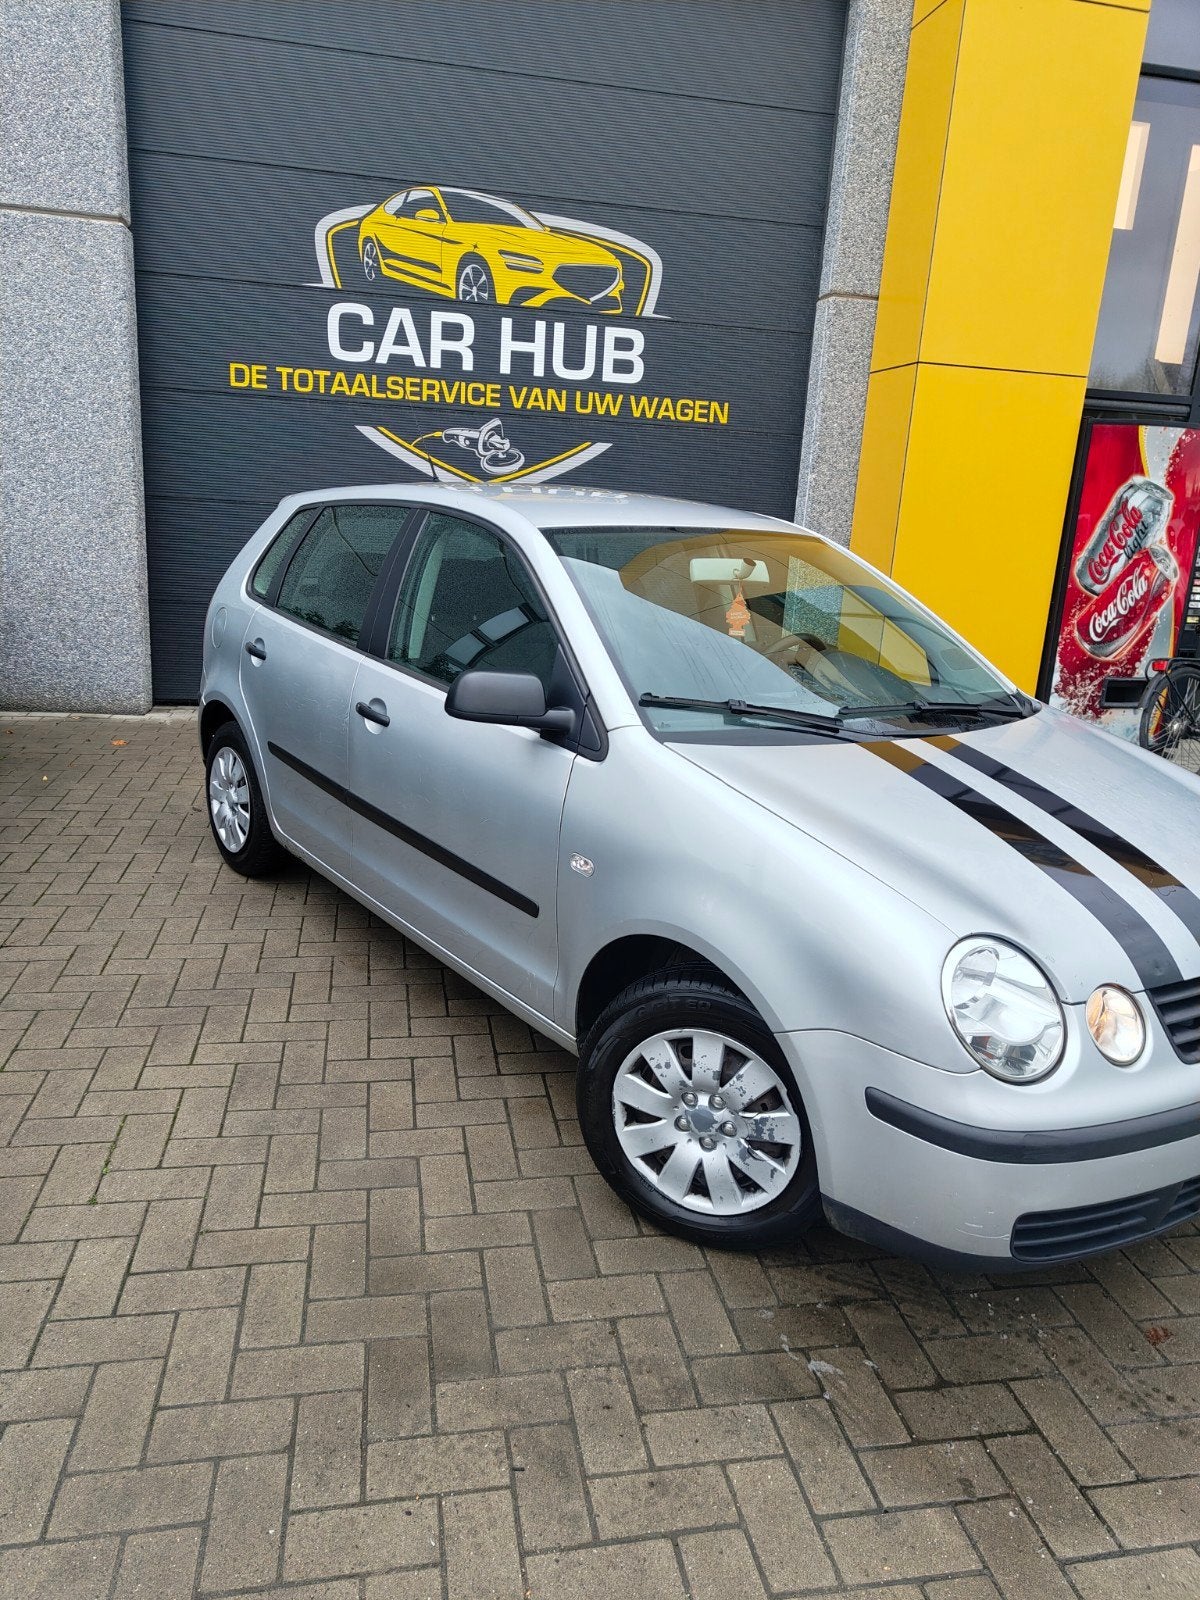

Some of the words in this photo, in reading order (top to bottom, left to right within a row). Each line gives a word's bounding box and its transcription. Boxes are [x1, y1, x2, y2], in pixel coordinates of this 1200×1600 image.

[326, 302, 476, 371] CAR
[499, 316, 645, 385] HUB
[229, 362, 267, 390] DE
[275, 366, 501, 408] TOTAALSERVICE
[508, 385, 567, 413] VAN
[575, 390, 624, 417] UW
[629, 395, 730, 425] WAGEN
[1088, 496, 1143, 585] Coca-Cola
[1089, 562, 1148, 642] Coca-Cola
